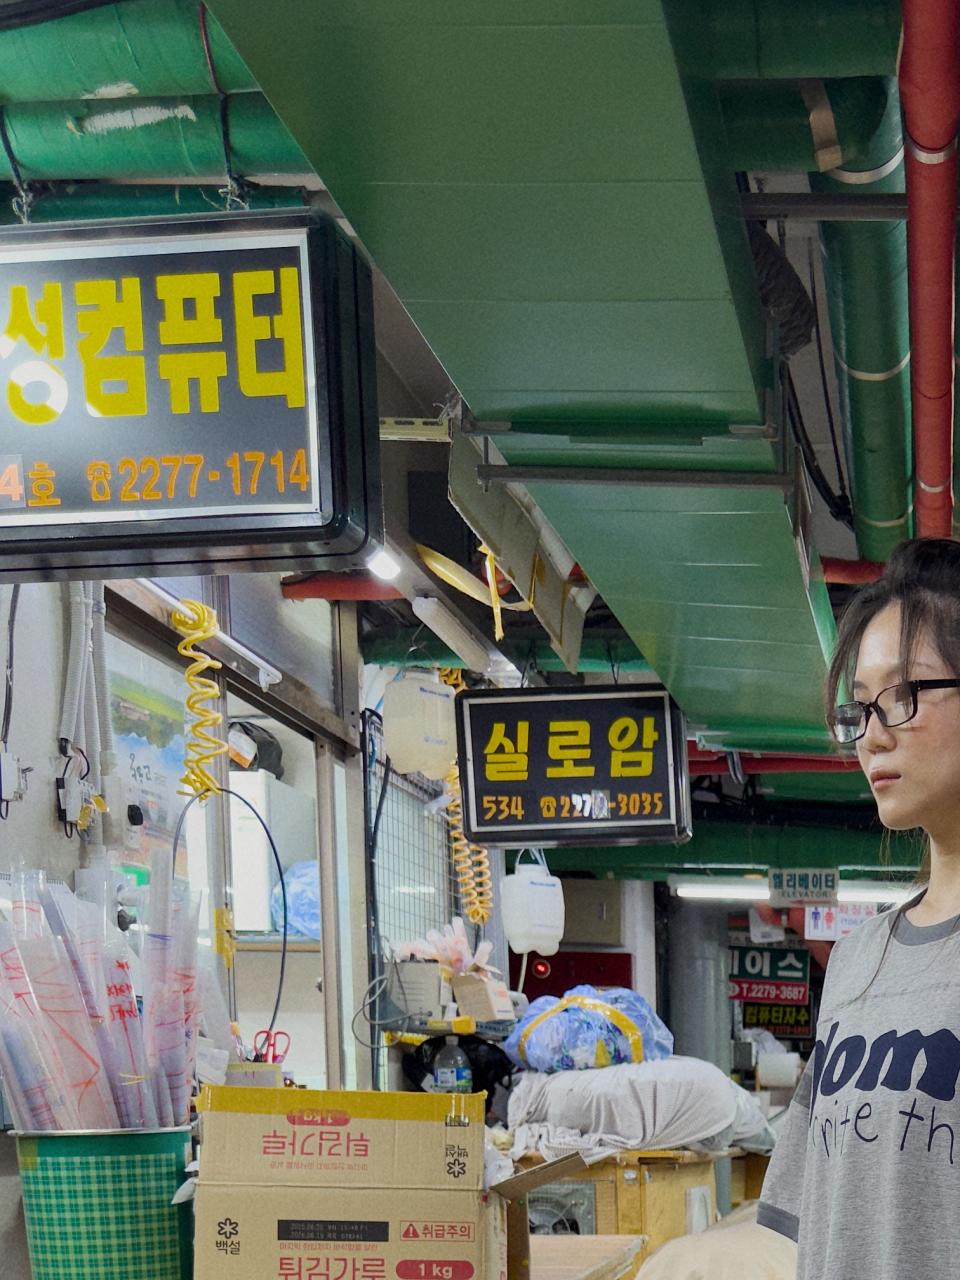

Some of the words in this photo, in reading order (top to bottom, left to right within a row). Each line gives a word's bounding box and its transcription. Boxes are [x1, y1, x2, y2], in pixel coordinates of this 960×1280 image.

[0, 267, 306, 426] 성컴퓨터
[118, 449, 310, 501] 2277-1714
[484, 716, 660, 782] 실로암
[482, 796, 525, 820] 534
[262, 1129, 371, 1158] 튀김가루
[422, 1225, 472, 1240] 취급주의
[215, 1240, 241, 1255] 백설
[419, 1264, 425, 1277] 1
[432, 1263, 453, 1280] kg
